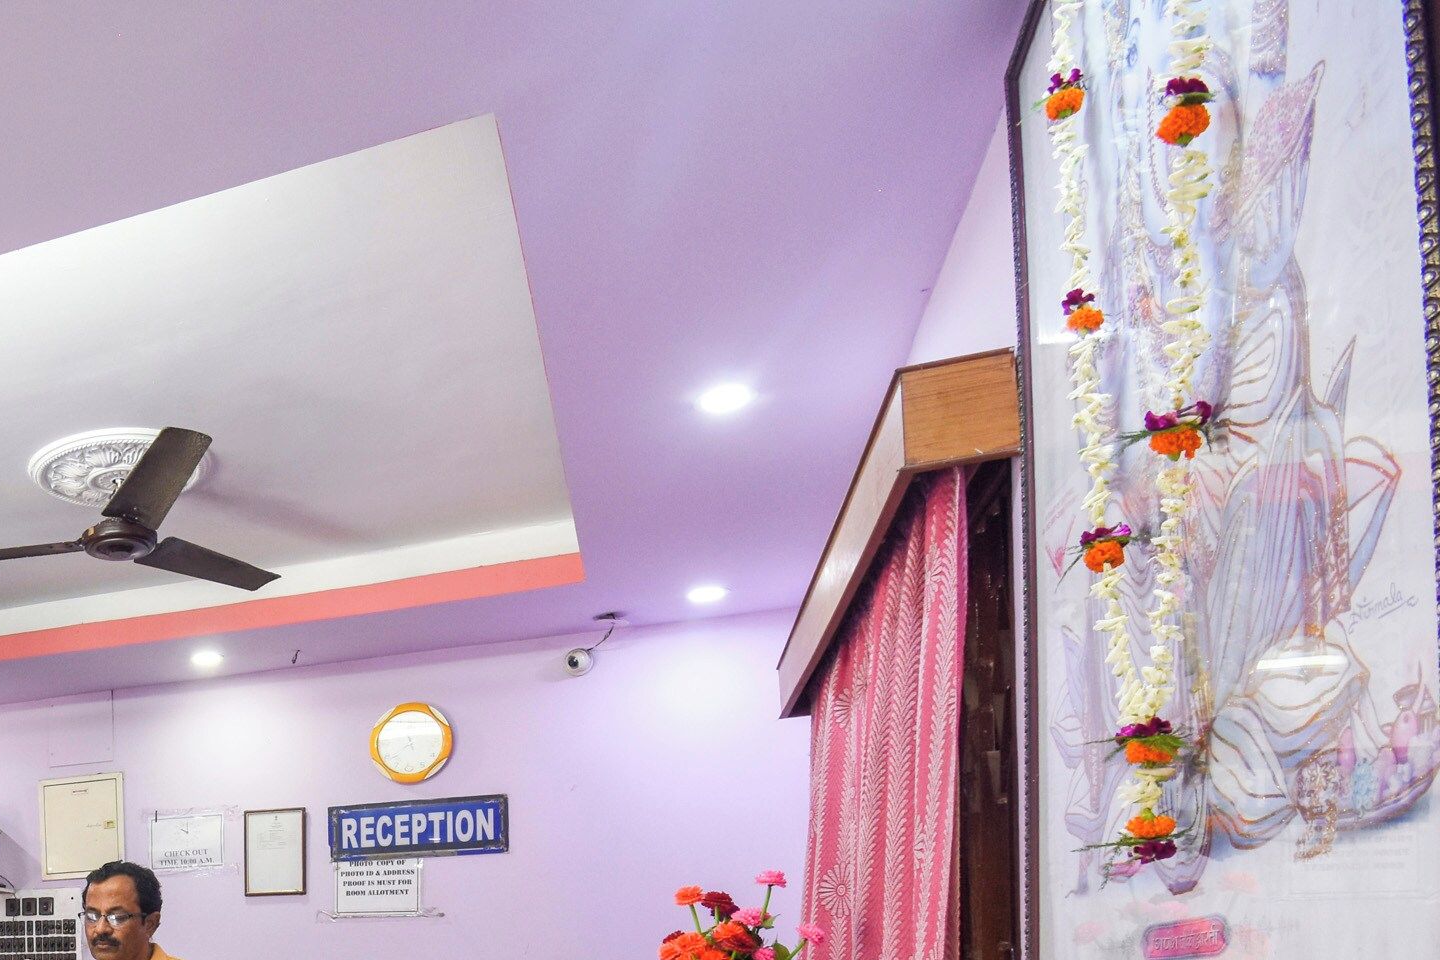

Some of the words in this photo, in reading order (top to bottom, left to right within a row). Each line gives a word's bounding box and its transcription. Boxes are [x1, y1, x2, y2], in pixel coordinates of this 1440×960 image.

[341, 808, 495, 849] RECEPTION
[376, 859, 394, 867] COPY
[382, 869, 415, 877] ADDRESS
[397, 878, 412, 886] FOR
[346, 889, 366, 897] ROOM
[367, 888, 410, 896] ALLOTMENT
